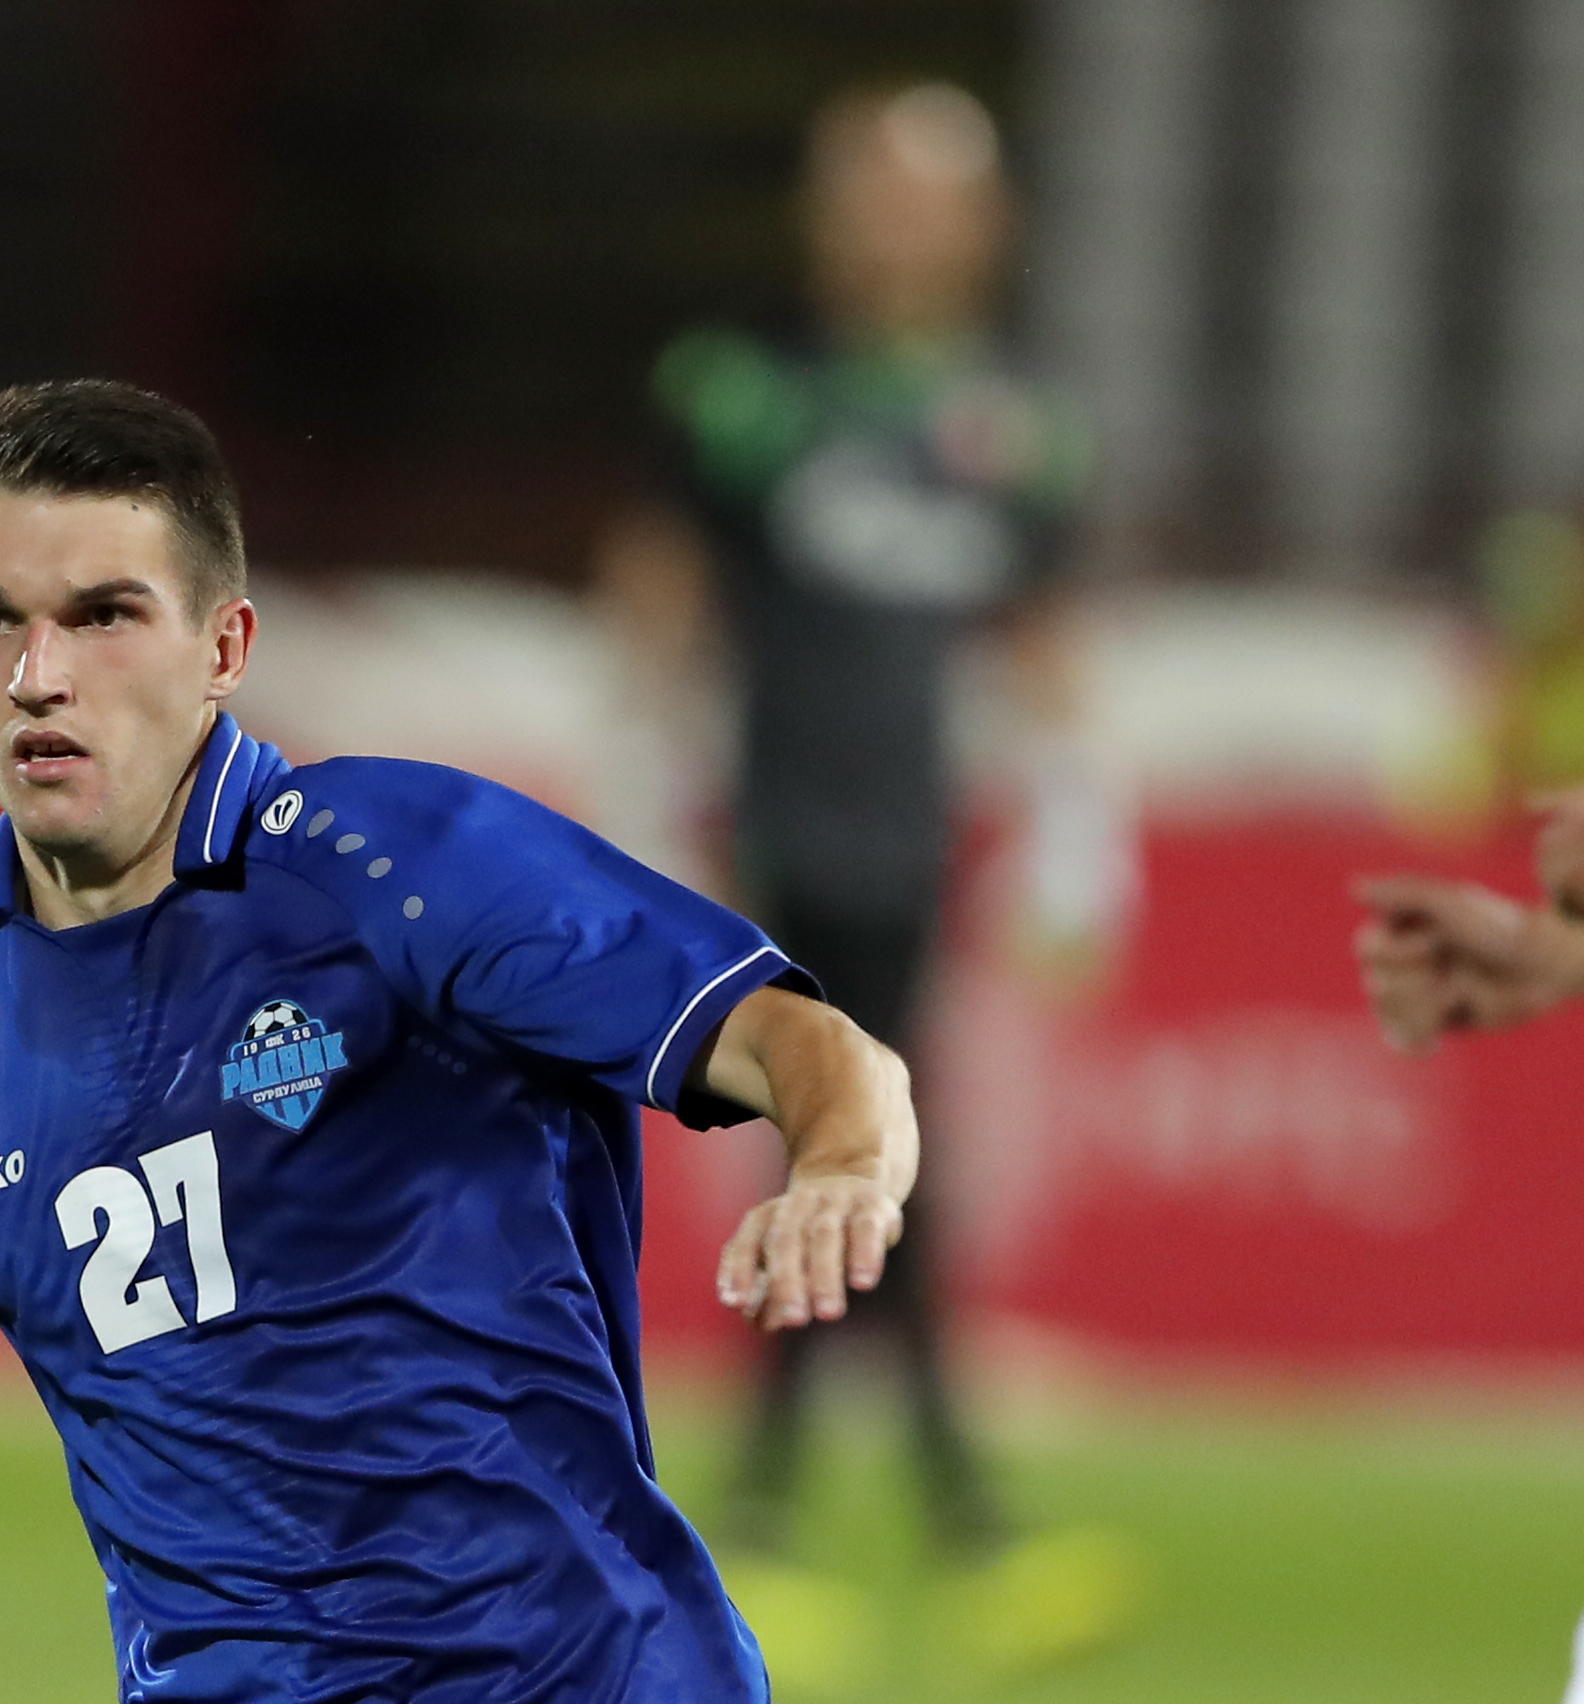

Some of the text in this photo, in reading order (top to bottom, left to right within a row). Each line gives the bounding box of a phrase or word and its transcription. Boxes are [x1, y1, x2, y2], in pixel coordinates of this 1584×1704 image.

[221, 1031, 349, 1101] РАДНИК
[243, 1042, 258, 1056] 19
[292, 1026, 311, 1041] 26
[252, 1076, 323, 1104] СУРДУЛИЦА
[53, 1129, 237, 1356] 27
